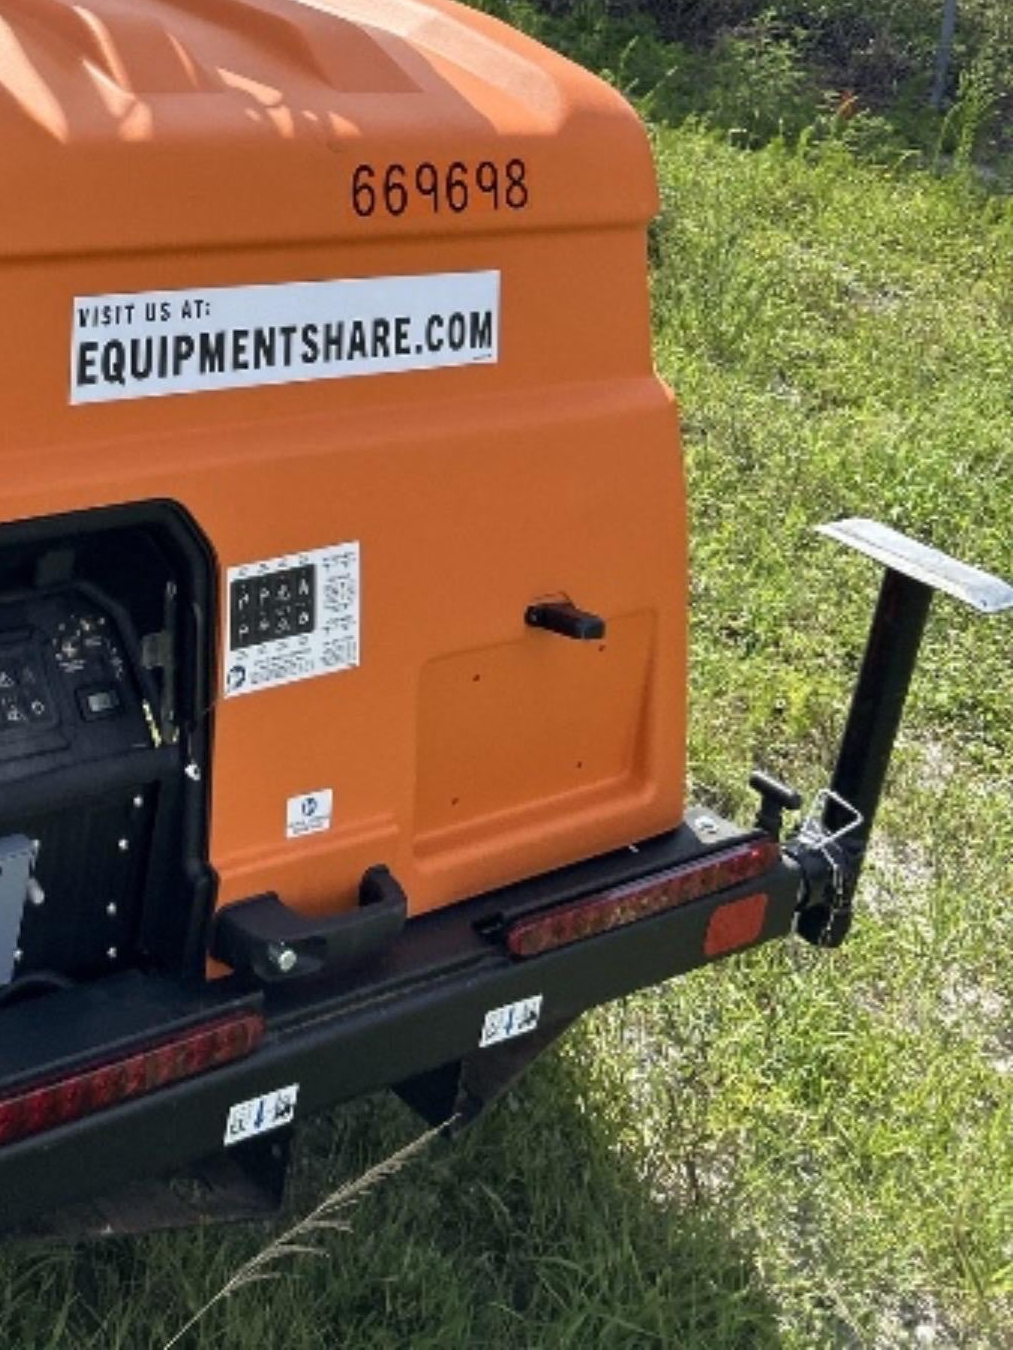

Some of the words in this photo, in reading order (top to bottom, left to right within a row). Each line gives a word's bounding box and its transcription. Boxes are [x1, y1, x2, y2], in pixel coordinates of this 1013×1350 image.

[353, 159, 528, 216] 669698
[77, 306, 136, 328] VISIT
[144, 301, 171, 323] US
[180, 300, 212, 320] AT:
[77, 311, 492, 387] EQUIPMENTSHARE.COM
